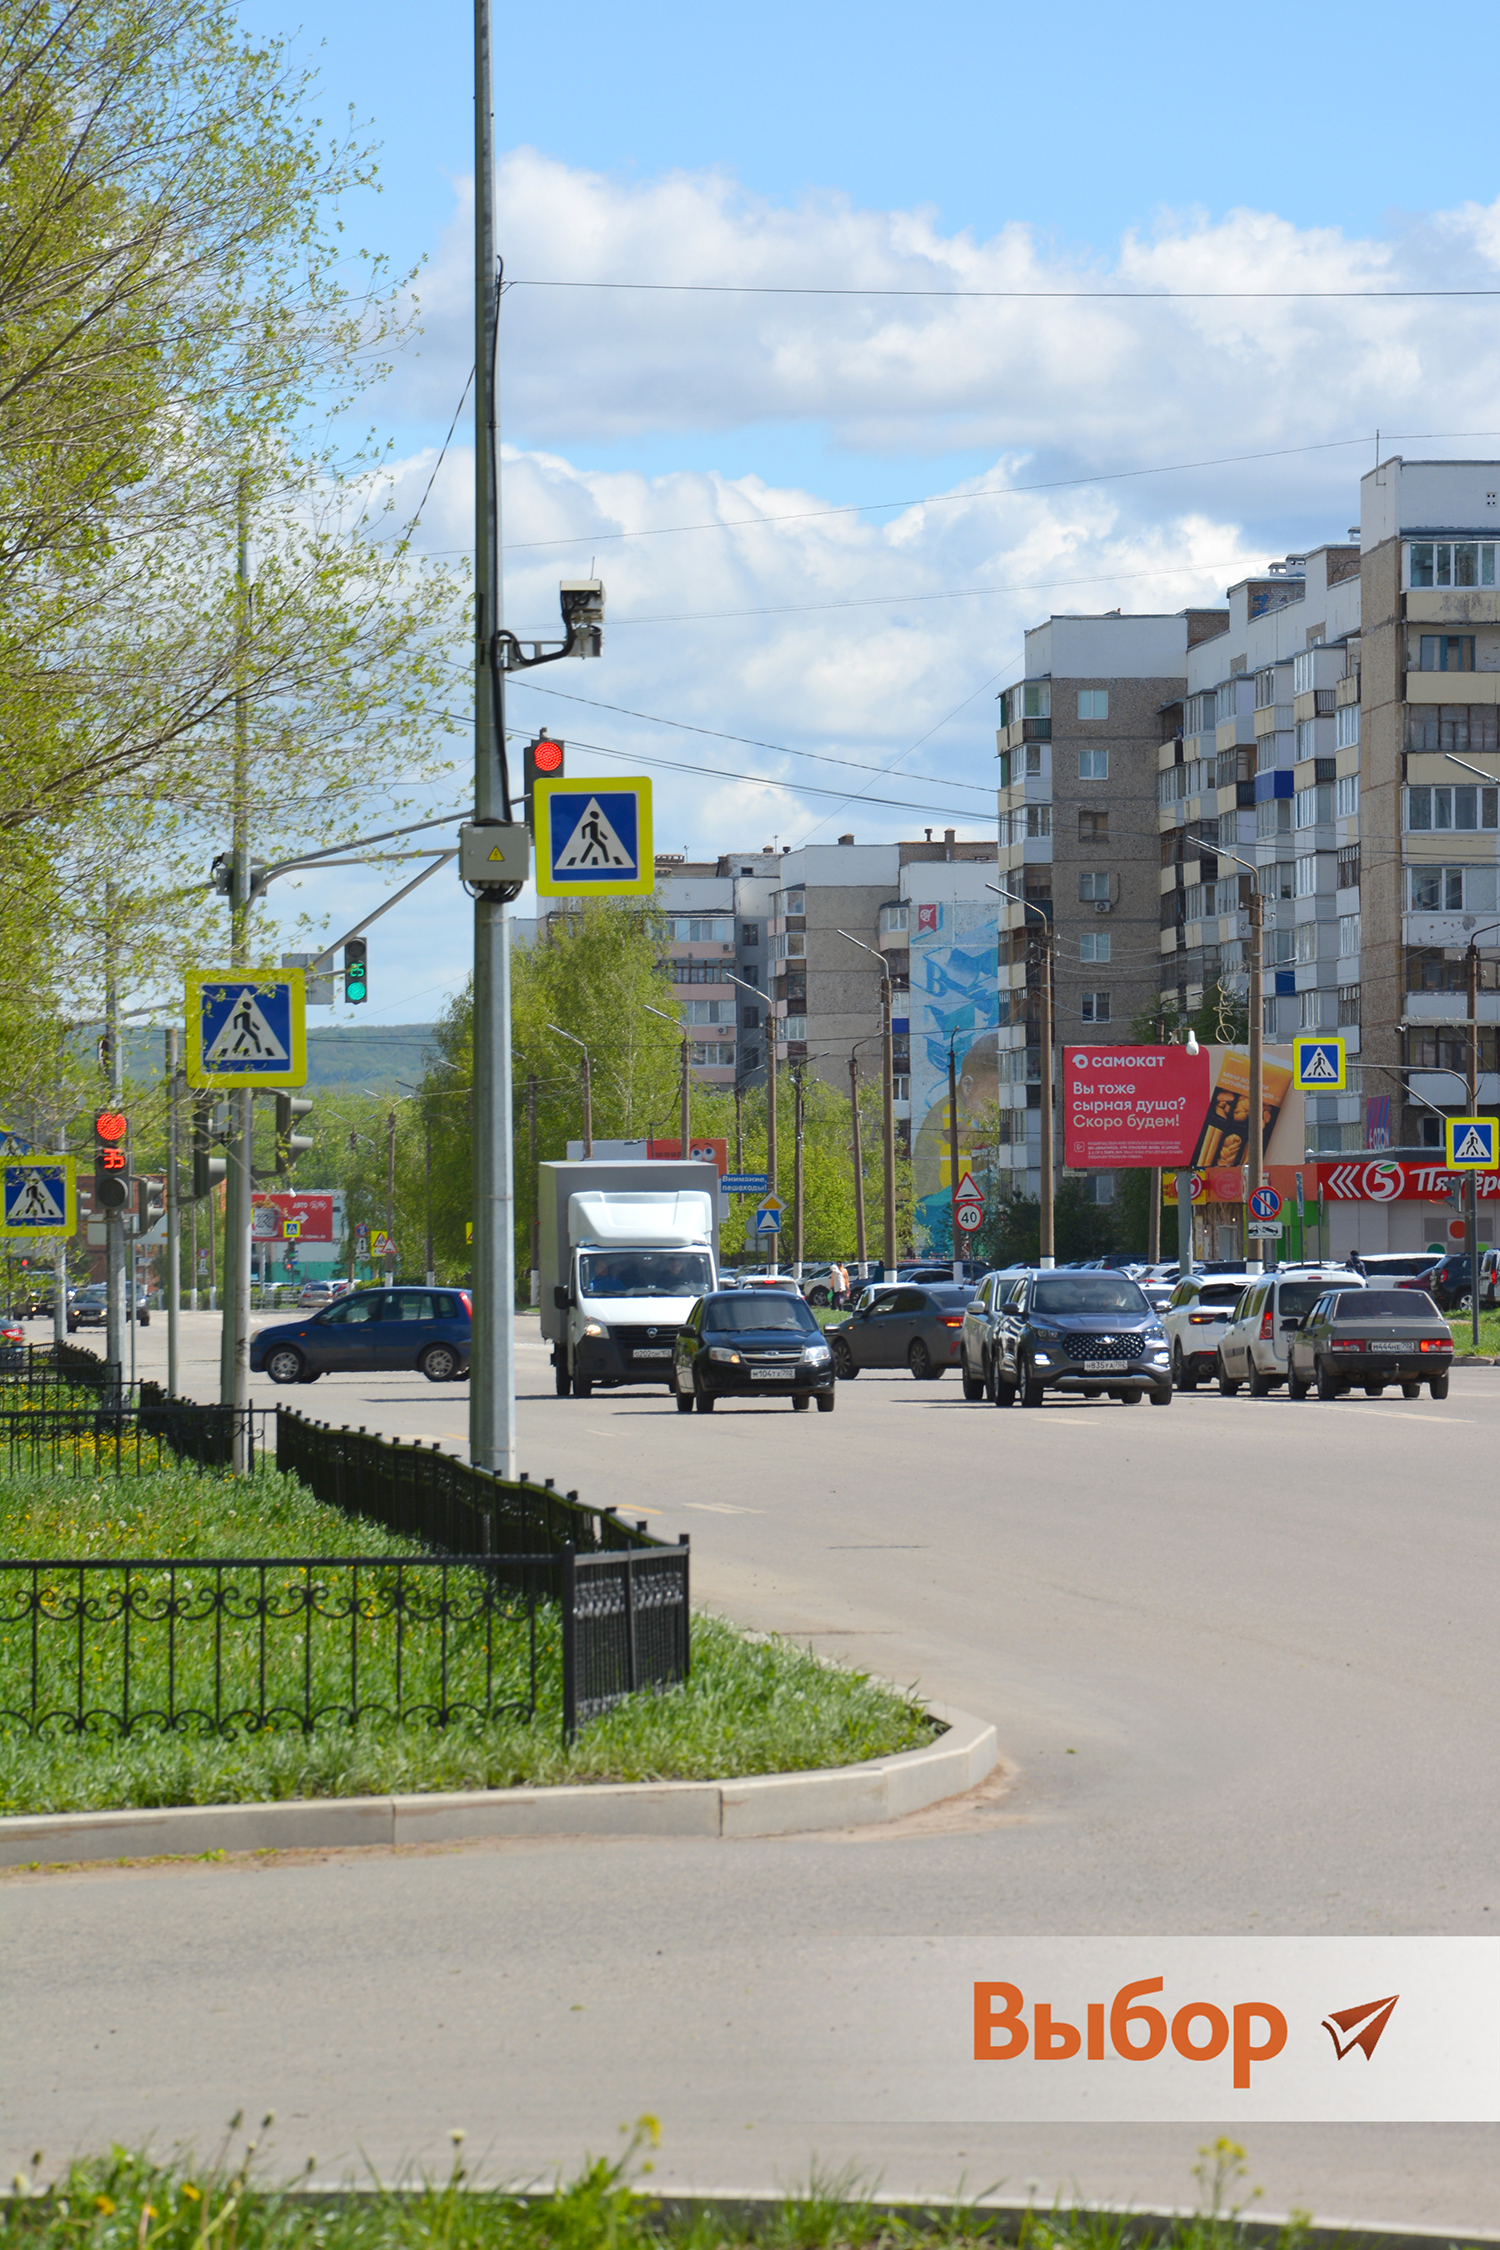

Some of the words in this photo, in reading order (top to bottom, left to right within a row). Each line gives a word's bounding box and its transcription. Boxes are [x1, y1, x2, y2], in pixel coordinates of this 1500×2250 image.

[1091, 1056, 1166, 1068] самокат
[1073, 1081, 1094, 1095] Вы
[1098, 1084, 1136, 1095] тоже
[1073, 1100, 1132, 1114] сырная
[1136, 1097, 1187, 1114] душа?
[1073, 1114, 1123, 1131] Скоро
[1127, 1113, 1180, 1131] будем!
[103, 1148, 125, 1169] 35
[722, 1175, 767, 1183] Внимание,
[722, 1184, 767, 1192] пешеходы!
[961, 1211, 977, 1223] 40
